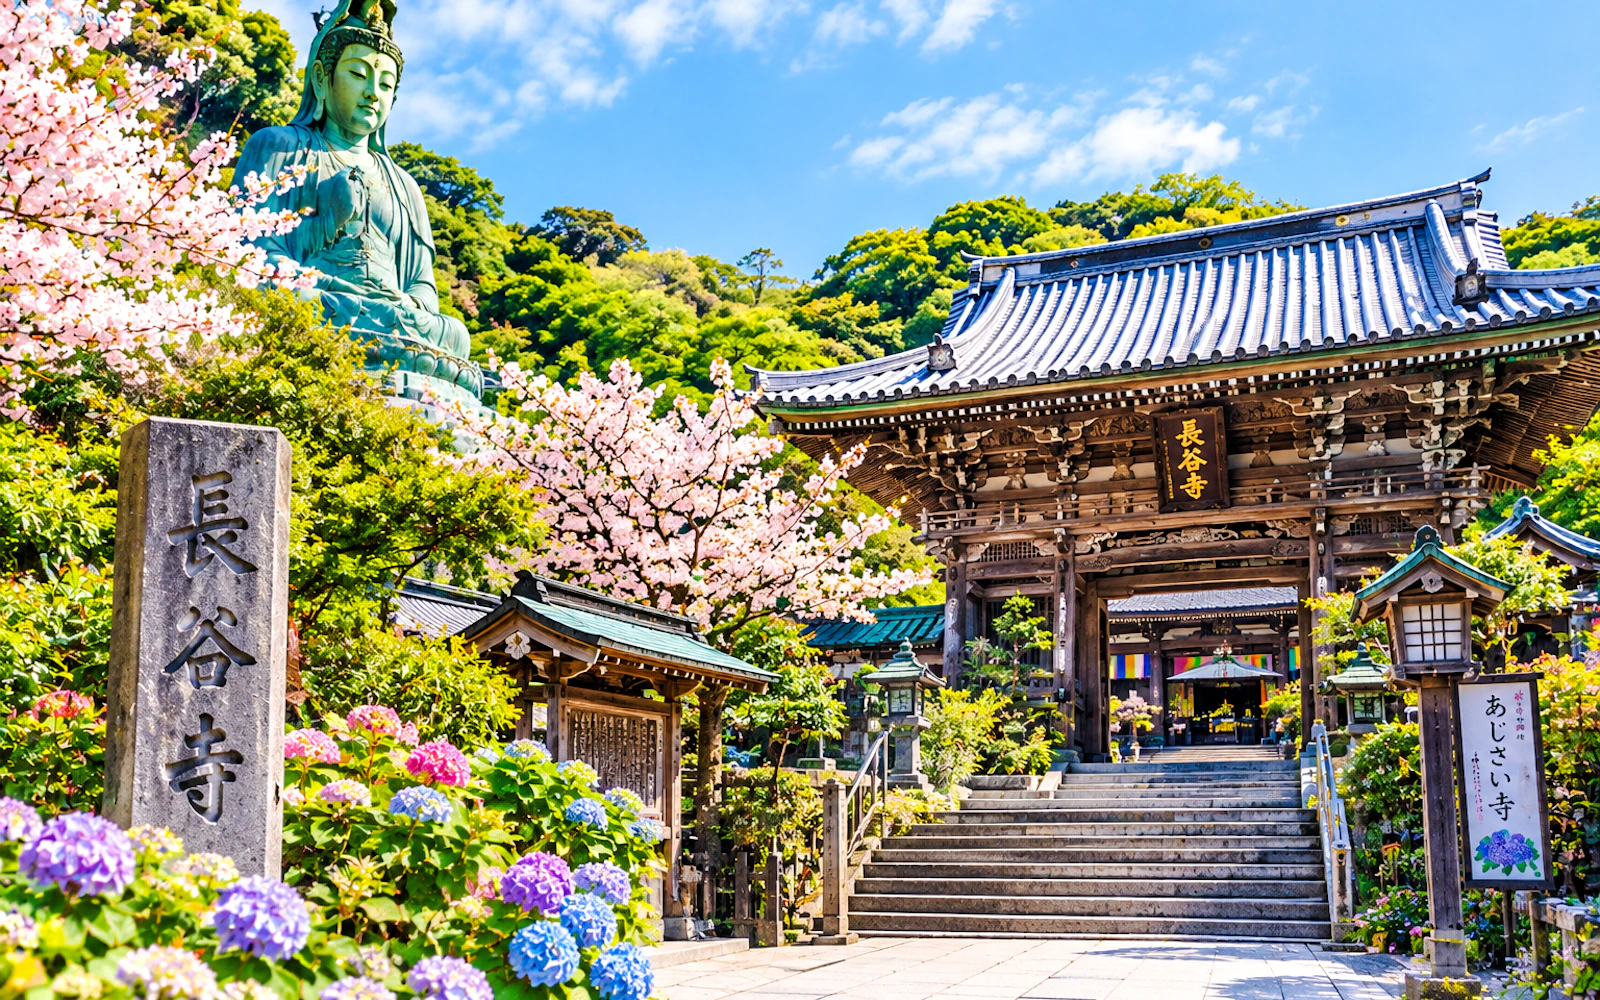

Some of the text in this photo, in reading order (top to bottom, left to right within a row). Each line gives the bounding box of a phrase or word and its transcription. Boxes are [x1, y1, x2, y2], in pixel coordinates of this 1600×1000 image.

[1175, 418, 1208, 500] 長谷寺
[160, 470, 258, 826] 長谷寺
[1485, 694, 1515, 822] あじさい寺
